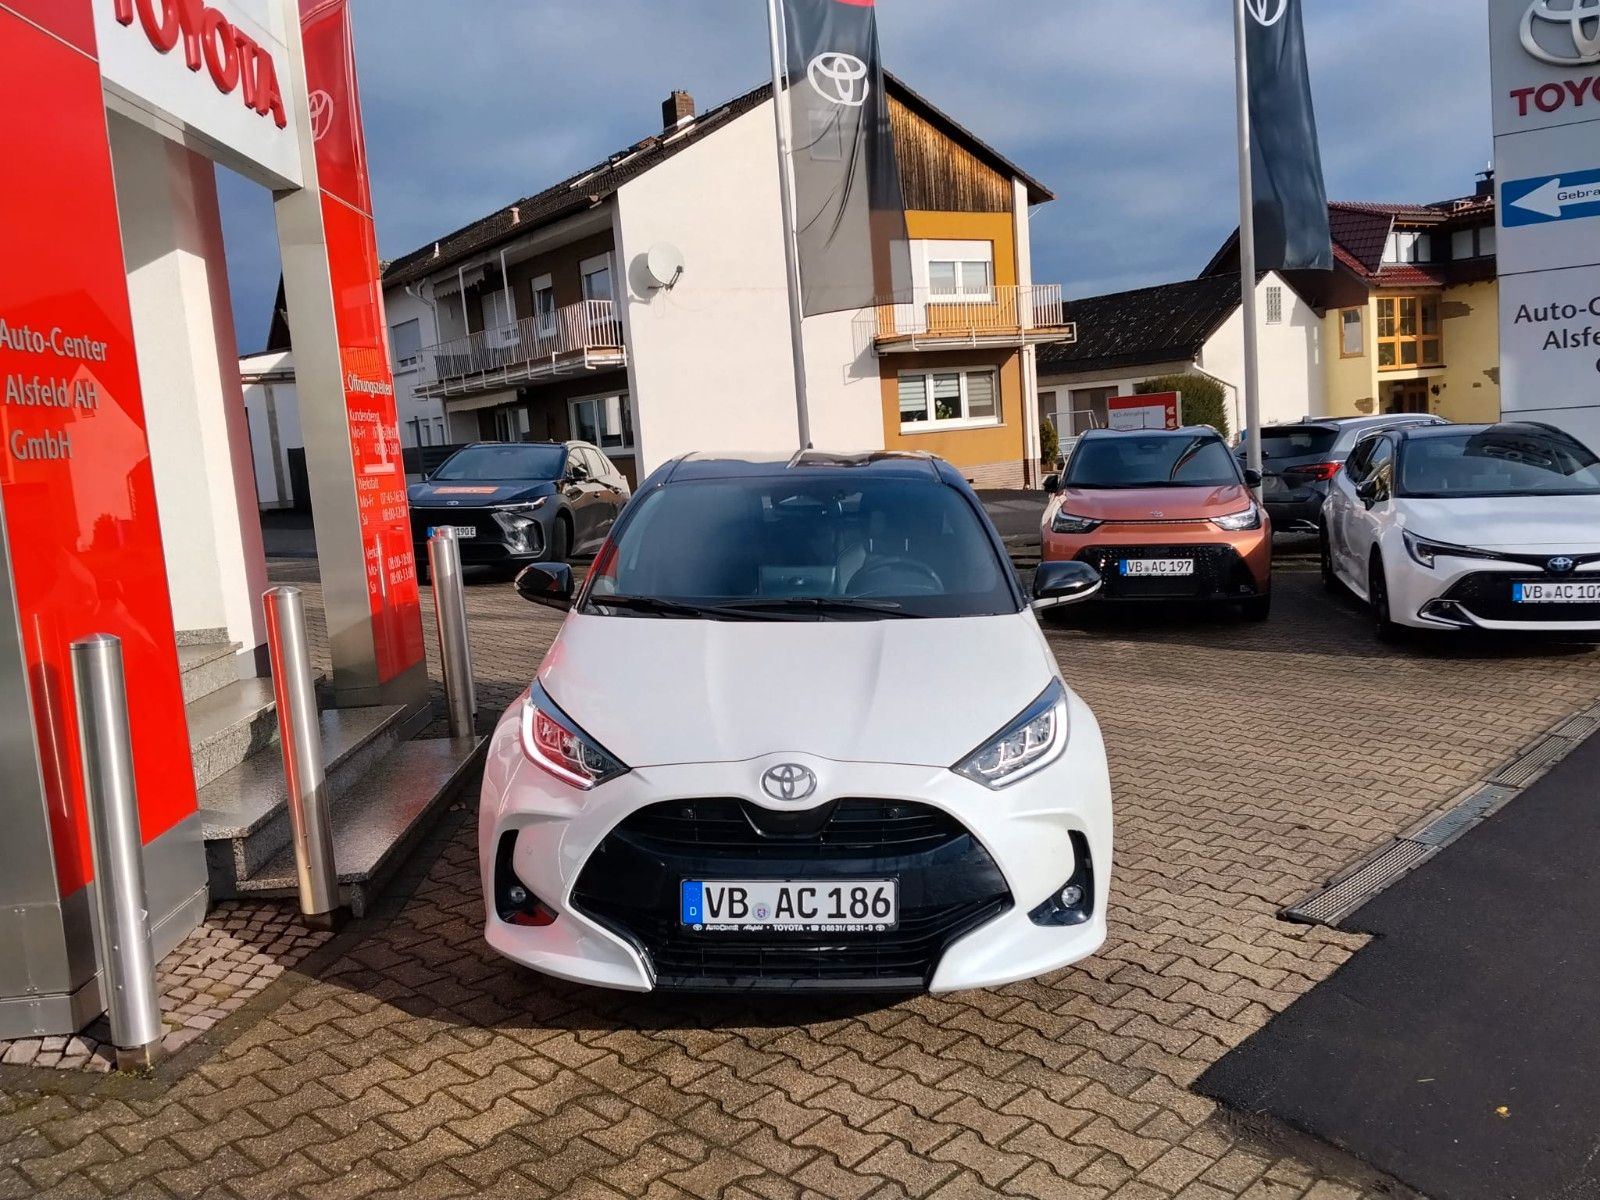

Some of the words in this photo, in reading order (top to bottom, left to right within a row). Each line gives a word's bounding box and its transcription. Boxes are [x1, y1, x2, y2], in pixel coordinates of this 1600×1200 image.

[1509, 76, 1600, 116] TOY
[0, 317, 107, 362] Auto-Center
[5, 373, 70, 408] Alsfeld
[73, 379, 99, 410] AH
[10, 428, 73, 461] GmbH
[1128, 561, 1142, 572] VB
[1151, 561, 1166, 572] AC
[1169, 561, 1192, 572] 197
[1523, 585, 1543, 598] VB
[1554, 585, 1573, 598] AC
[705, 887, 749, 919] VB
[775, 887, 818, 919] AC
[827, 887, 891, 919] 186
